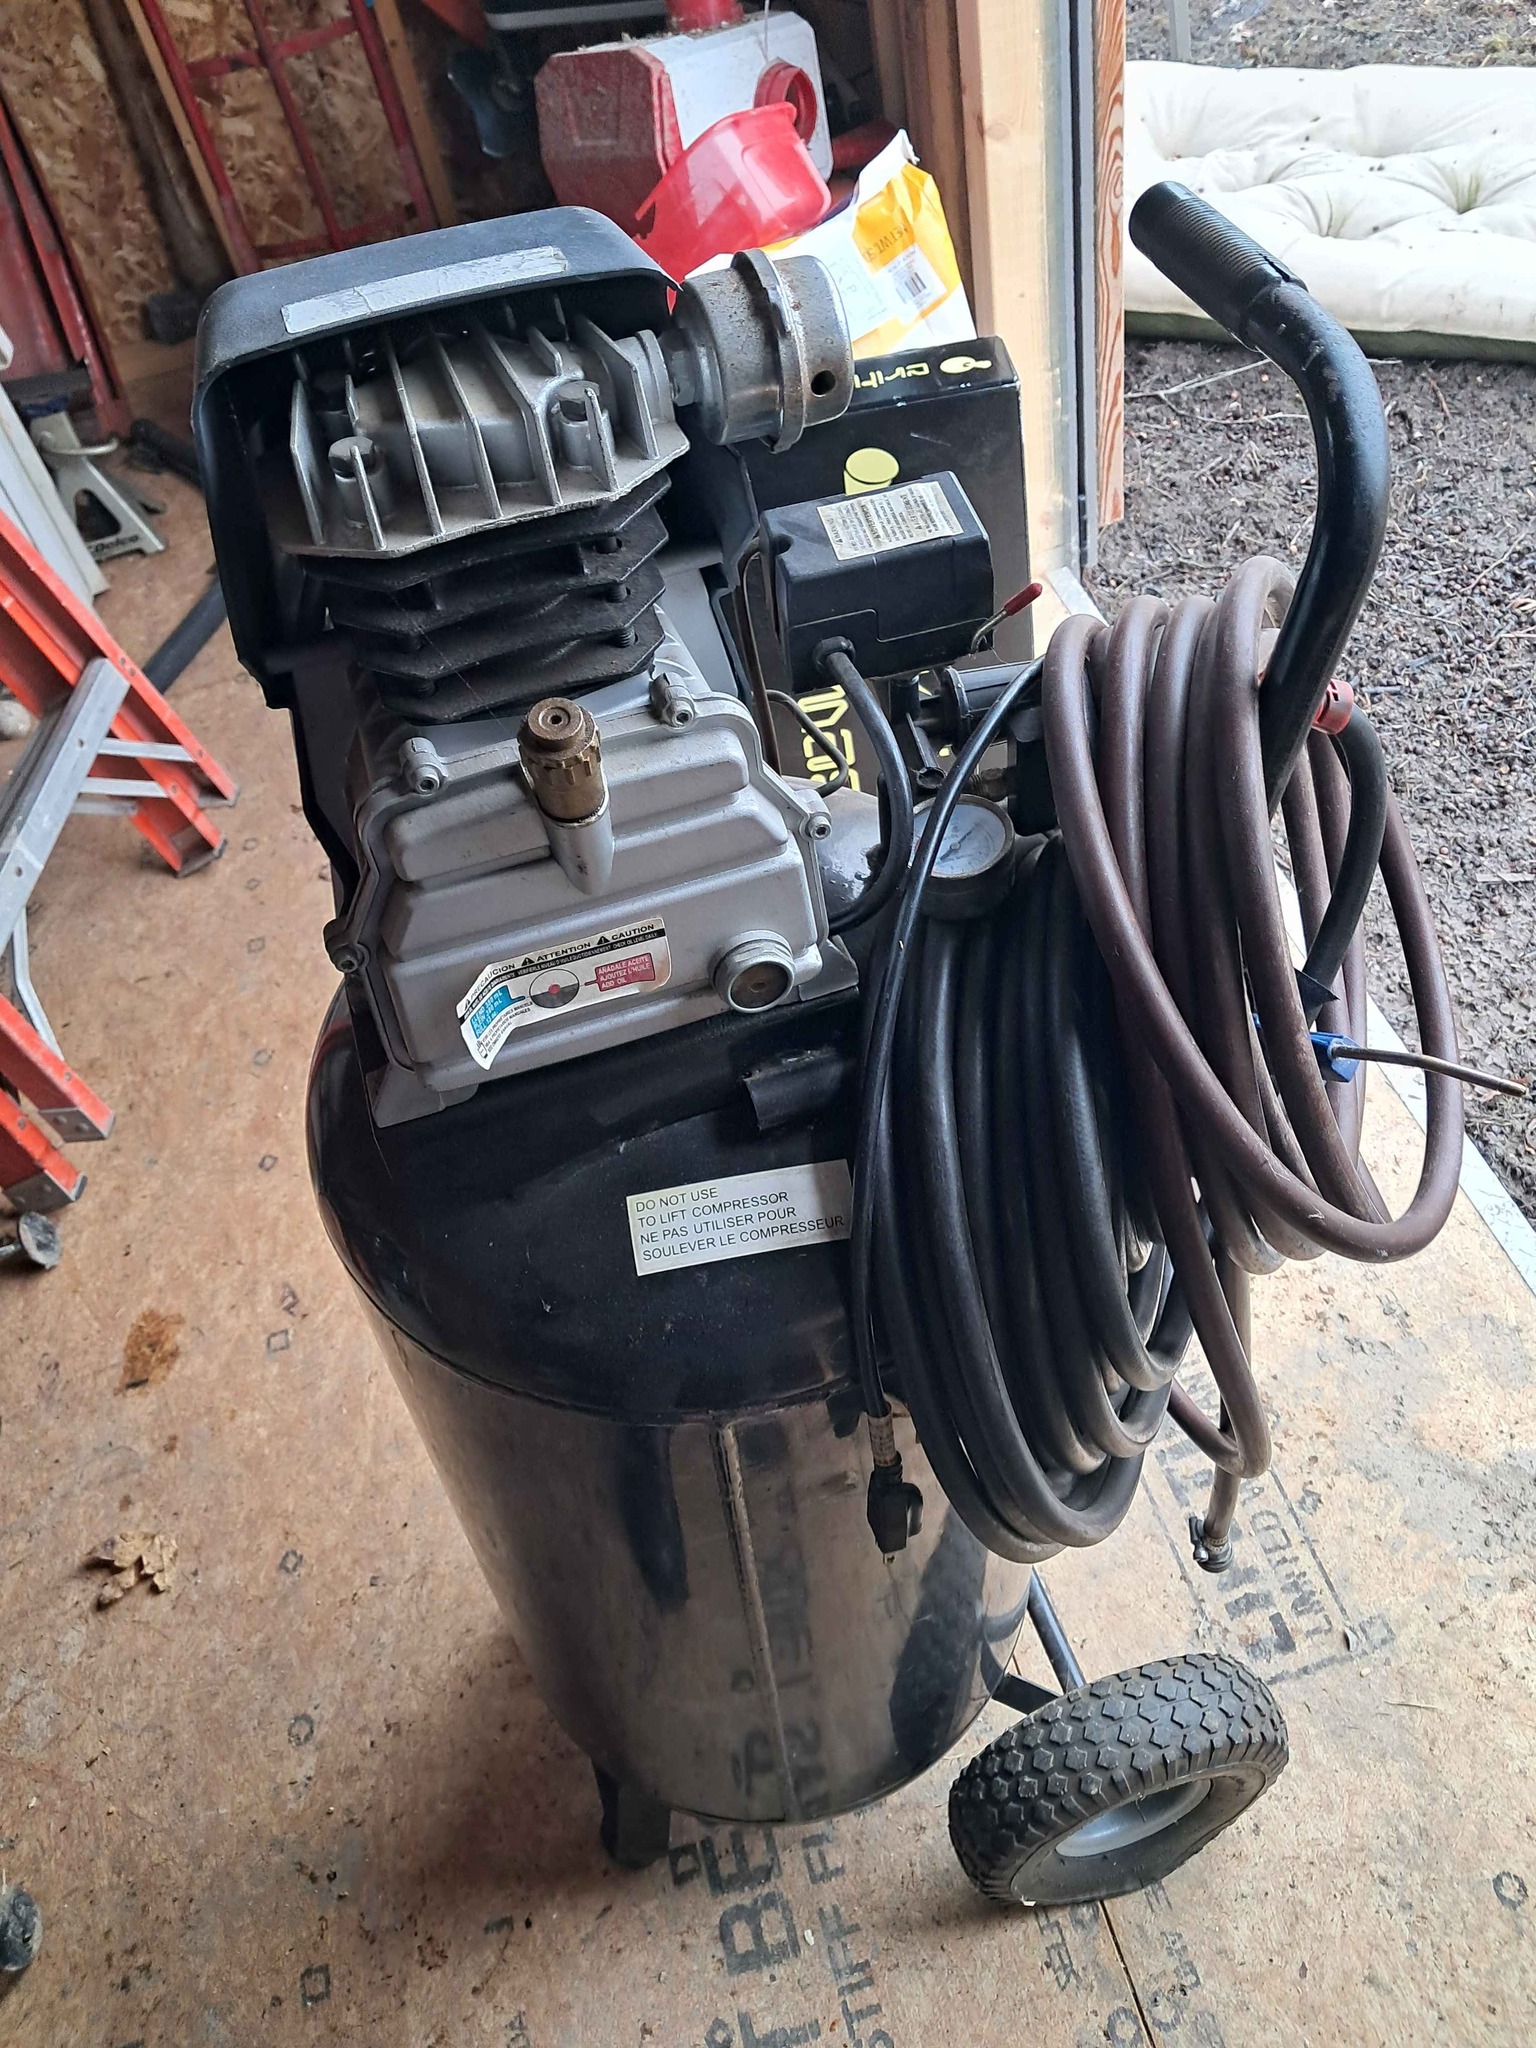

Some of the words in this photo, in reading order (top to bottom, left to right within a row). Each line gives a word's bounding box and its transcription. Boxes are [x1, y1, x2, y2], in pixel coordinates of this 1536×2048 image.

[611, 924, 655, 941] CAUTION
[536, 942, 591, 962] ATTENTION
[627, 955, 649, 966] ACEITE
[471, 964, 515, 1000] PRECAUCION
[599, 970, 627, 982] AJOUTEZ
[627, 963, 651, 974] L'HUILE
[601, 980, 614, 989] ADD
[636, 1199, 655, 1212] DO
[659, 1193, 687, 1208] NOT
[690, 1188, 718, 1201] USE
[638, 1216, 656, 1228] TO
[660, 1210, 687, 1224] LIFT
[692, 1192, 788, 1218] COMPRESSOR
[640, 1232, 659, 1244] NE
[663, 1227, 688, 1240] PAS
[694, 1214, 754, 1234] UTILISER
[758, 1207, 796, 1222] POUR
[643, 1237, 716, 1261] SOULEVER
[720, 1232, 735, 1246] LE
[740, 1216, 844, 1242] COMPRESSEUR
